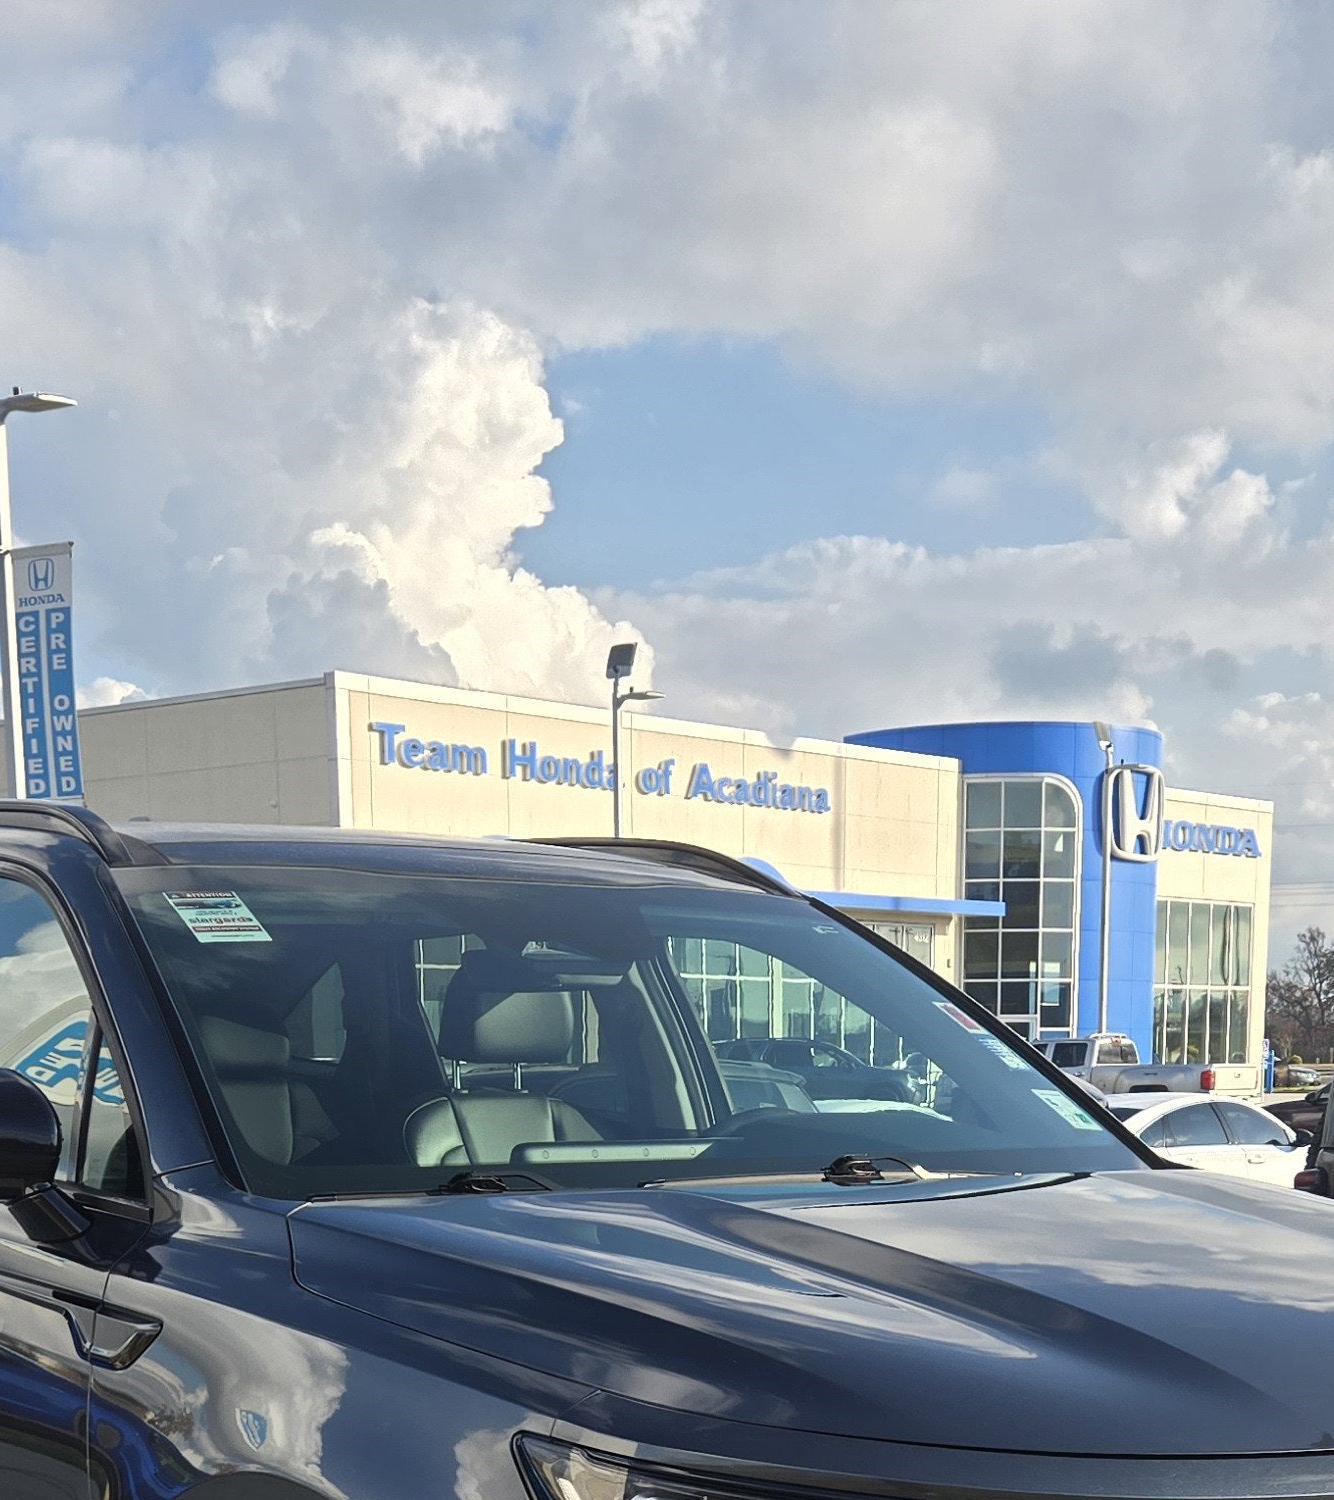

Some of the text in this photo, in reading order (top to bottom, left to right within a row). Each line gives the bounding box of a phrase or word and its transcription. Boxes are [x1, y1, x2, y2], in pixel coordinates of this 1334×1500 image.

[18, 593, 65, 607] HONDA
[18, 616, 46, 794] CERTIFIED
[50, 612, 76, 792] PRE OWNED
[368, 722, 488, 774] Team
[635, 758, 675, 796] of
[684, 763, 831, 814] Acadiana
